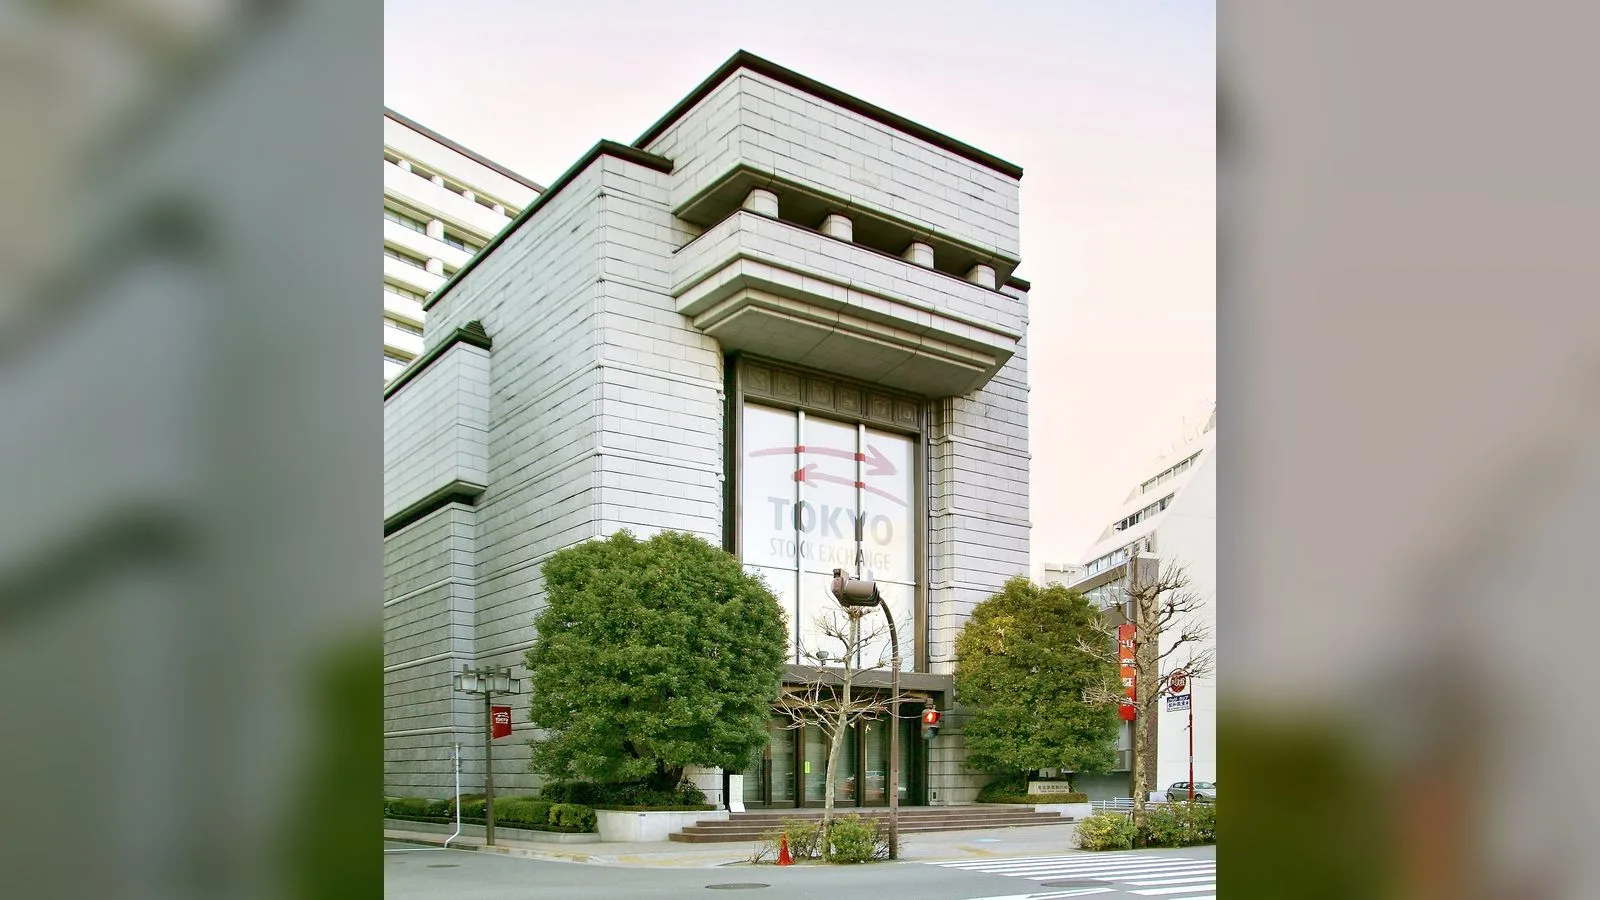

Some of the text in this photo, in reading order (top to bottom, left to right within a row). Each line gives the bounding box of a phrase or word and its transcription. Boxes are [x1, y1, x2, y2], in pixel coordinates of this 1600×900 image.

[767, 496, 893, 546] TOKYO
[770, 538, 890, 570] STOCK EXCHANGE
